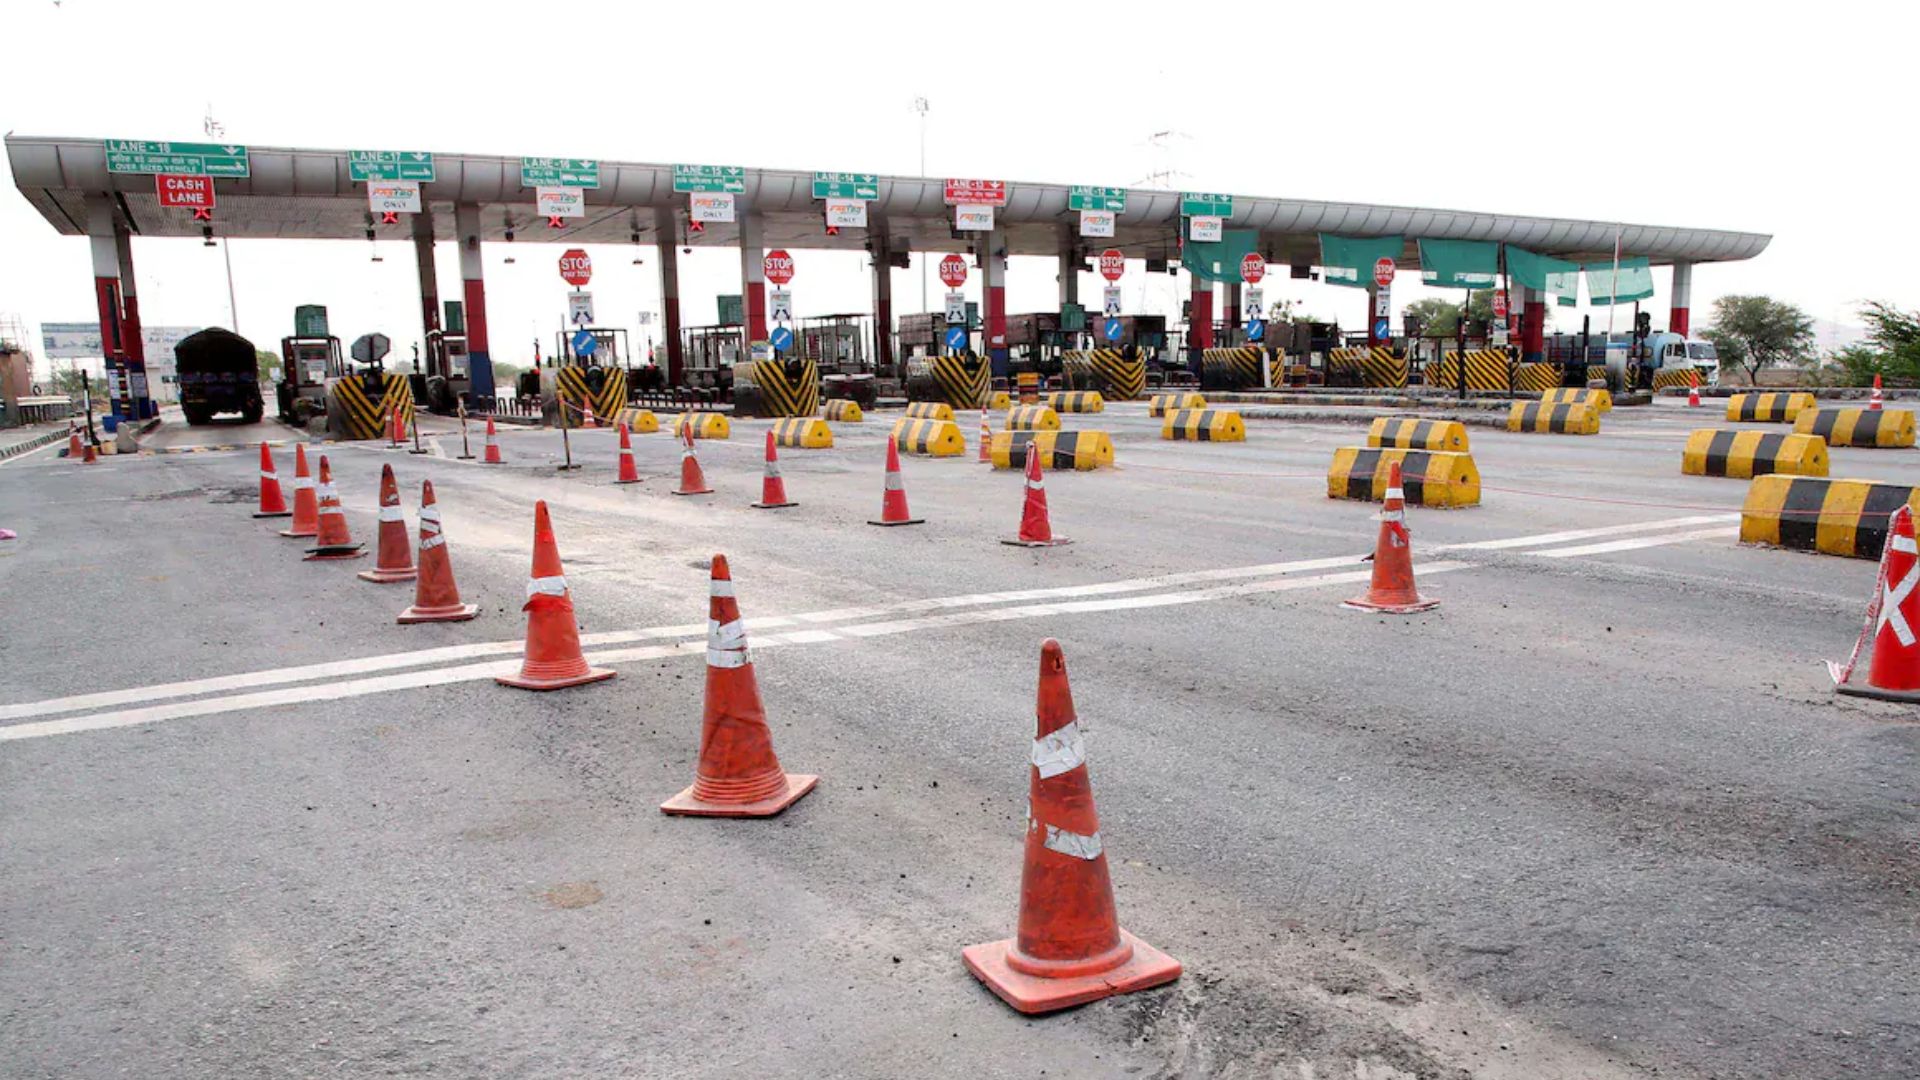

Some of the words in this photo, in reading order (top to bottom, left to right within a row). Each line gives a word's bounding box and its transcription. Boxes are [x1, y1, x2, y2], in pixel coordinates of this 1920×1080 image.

[110, 140, 147, 153] LANE
[115, 163, 136, 171] OVER
[141, 164, 162, 172] SIZED
[165, 164, 196, 173] VEHICLE
[166, 178, 205, 190] CASH
[168, 191, 205, 204] LANE
[561, 257, 591, 271] STOP
[765, 257, 794, 270] STOP
[941, 261, 966, 273] STOP
[1101, 256, 1124, 268] STOP
[1241, 261, 1265, 271] STOP
[1376, 264, 1395, 273] STOP
